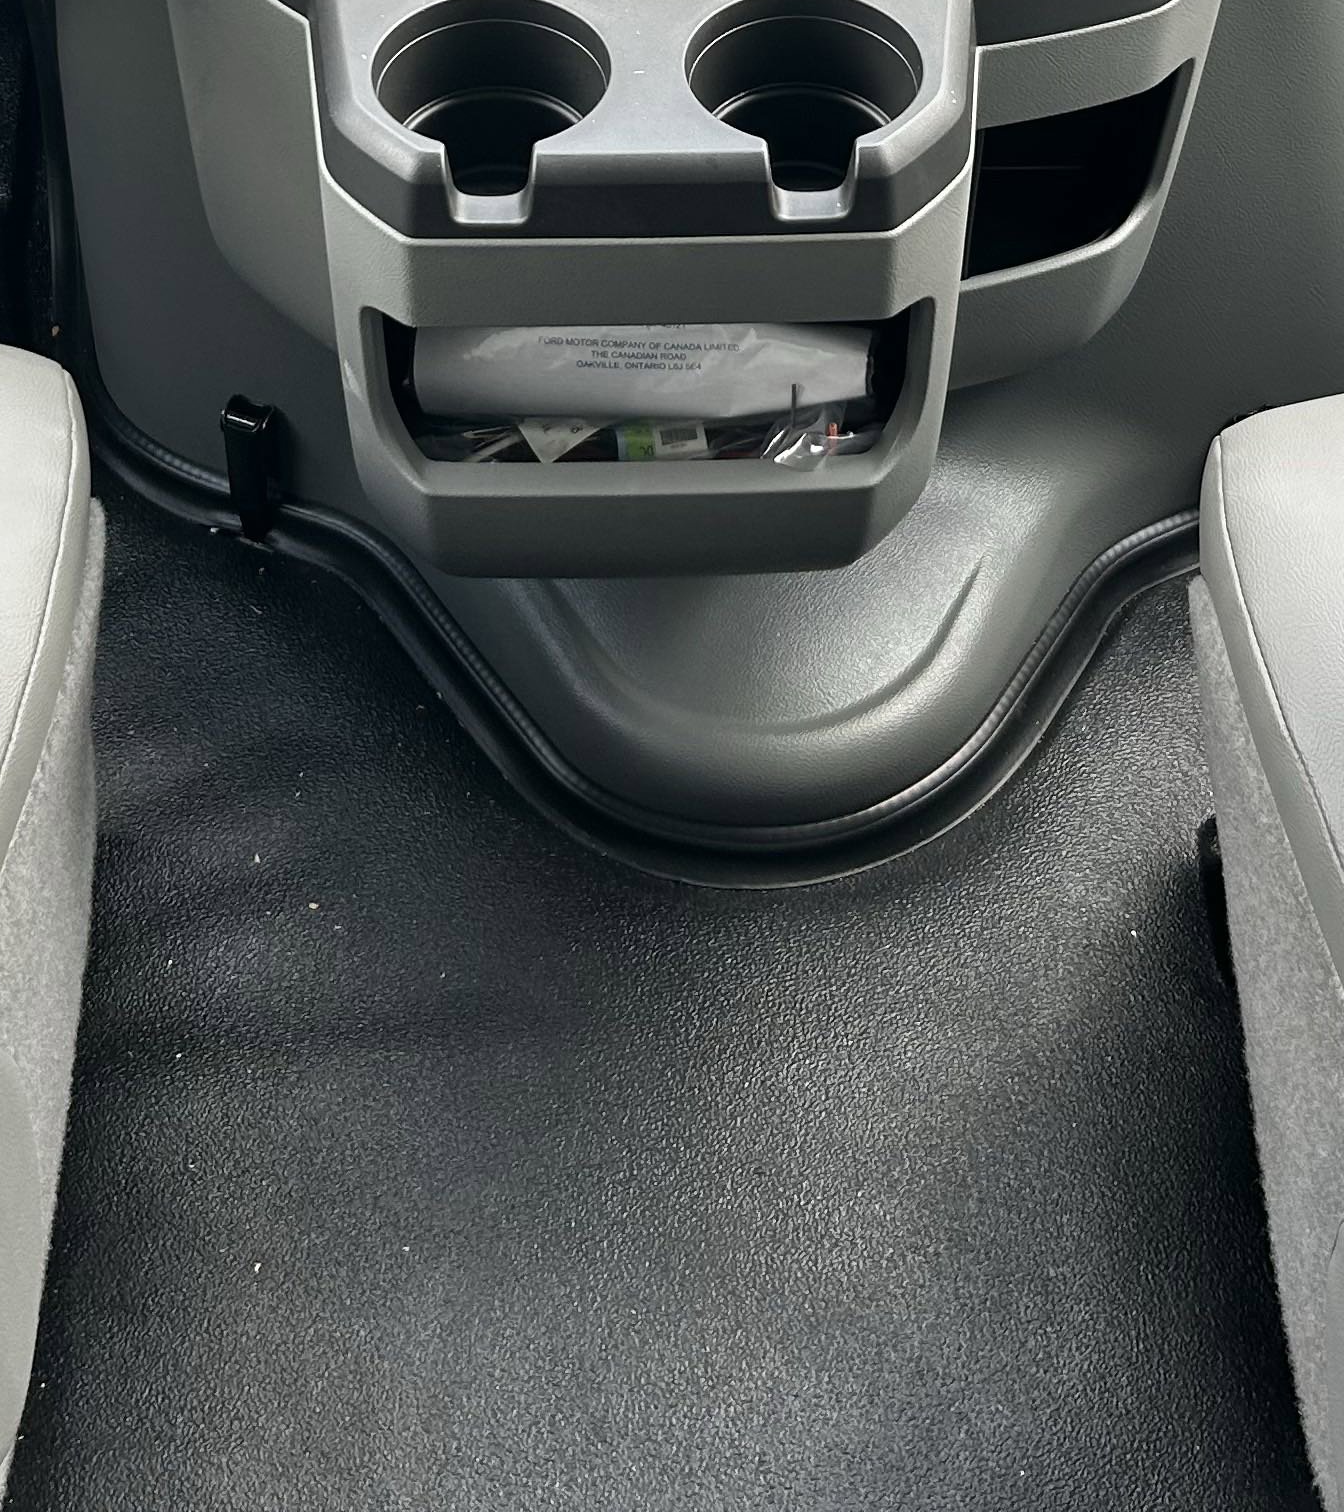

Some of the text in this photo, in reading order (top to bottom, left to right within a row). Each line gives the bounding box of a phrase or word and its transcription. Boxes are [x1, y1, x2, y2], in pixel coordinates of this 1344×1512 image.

[565, 338, 599, 347] MOTOR
[601, 340, 646, 349] COMPANY
[648, 342, 660, 350] OF
[664, 342, 702, 351] CANADA
[591, 350, 687, 361] THE CANADIAN ROAD
